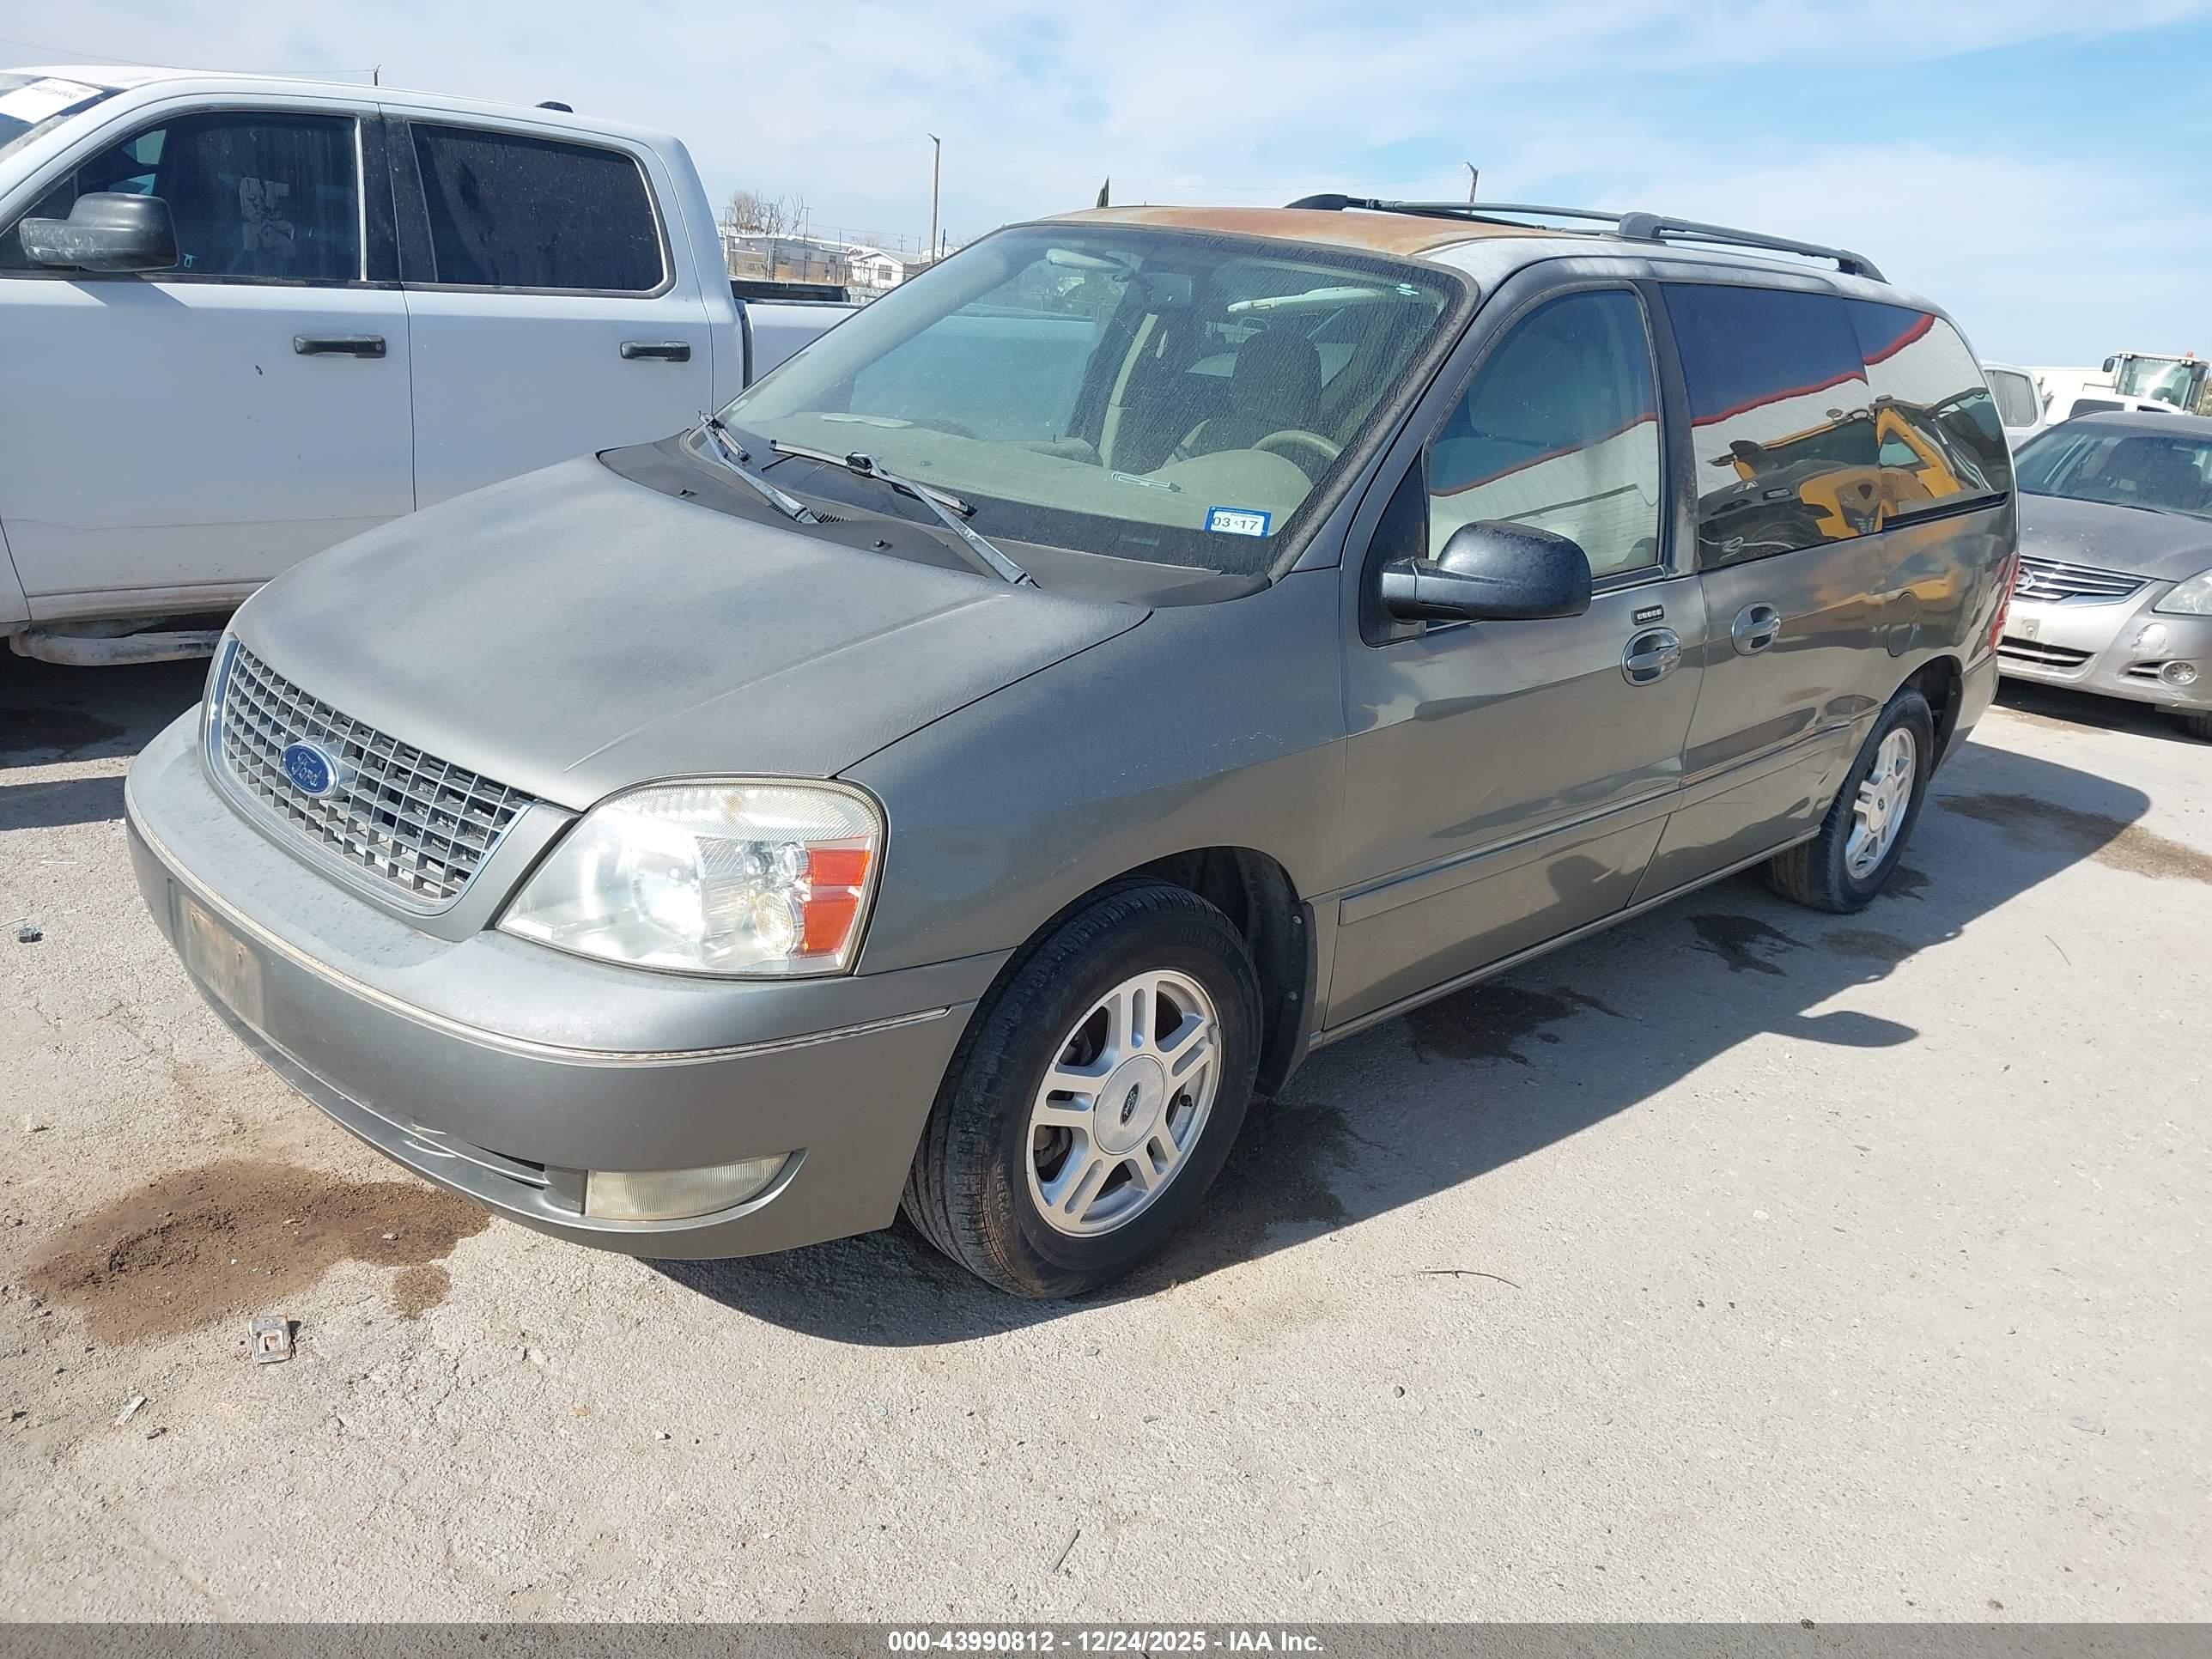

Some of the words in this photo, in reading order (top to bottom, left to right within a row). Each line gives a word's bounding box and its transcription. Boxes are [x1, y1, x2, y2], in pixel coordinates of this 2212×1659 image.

[1212, 516, 1231, 528] 03
[1240, 520, 1258, 530] 17
[291, 750, 323, 787] Ford
